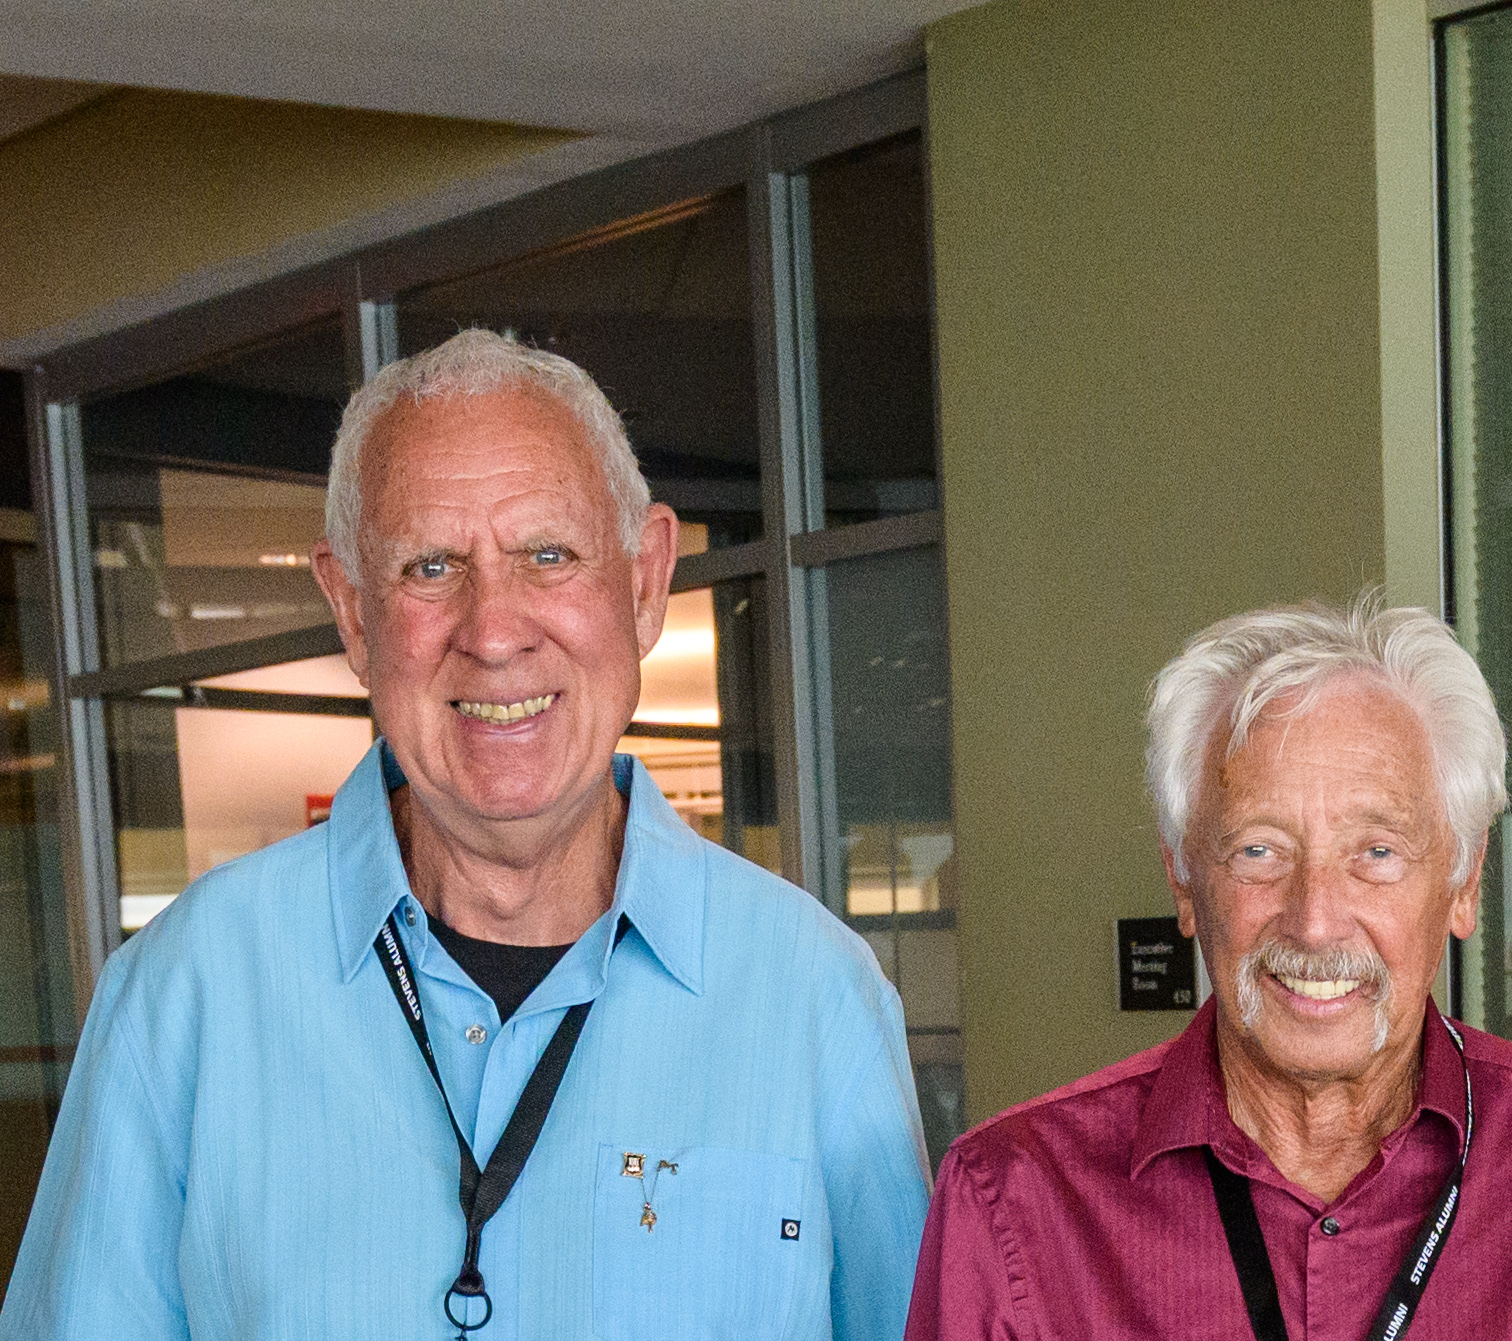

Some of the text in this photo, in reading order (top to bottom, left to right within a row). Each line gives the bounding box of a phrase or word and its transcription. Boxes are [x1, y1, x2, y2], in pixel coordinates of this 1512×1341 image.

[381, 923, 422, 1021] STEVENS ALUMN
[1409, 1185, 1459, 1286] STEVENS ALUMNI
